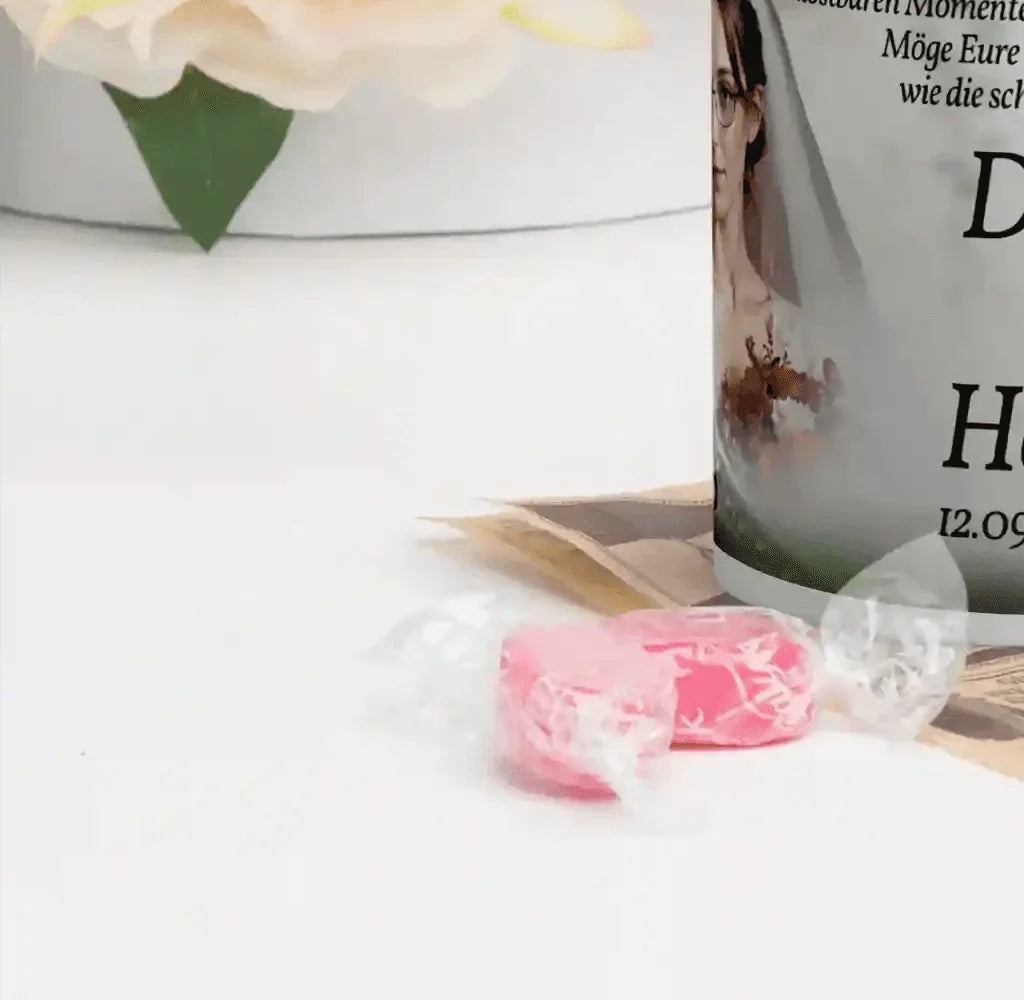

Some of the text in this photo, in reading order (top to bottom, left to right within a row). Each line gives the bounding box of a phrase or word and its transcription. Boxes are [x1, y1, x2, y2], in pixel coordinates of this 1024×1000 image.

[881, 27, 954, 74] Möge
[957, 33, 1021, 67] Eure
[899, 73, 942, 107] wie
[945, 75, 985, 109] die
